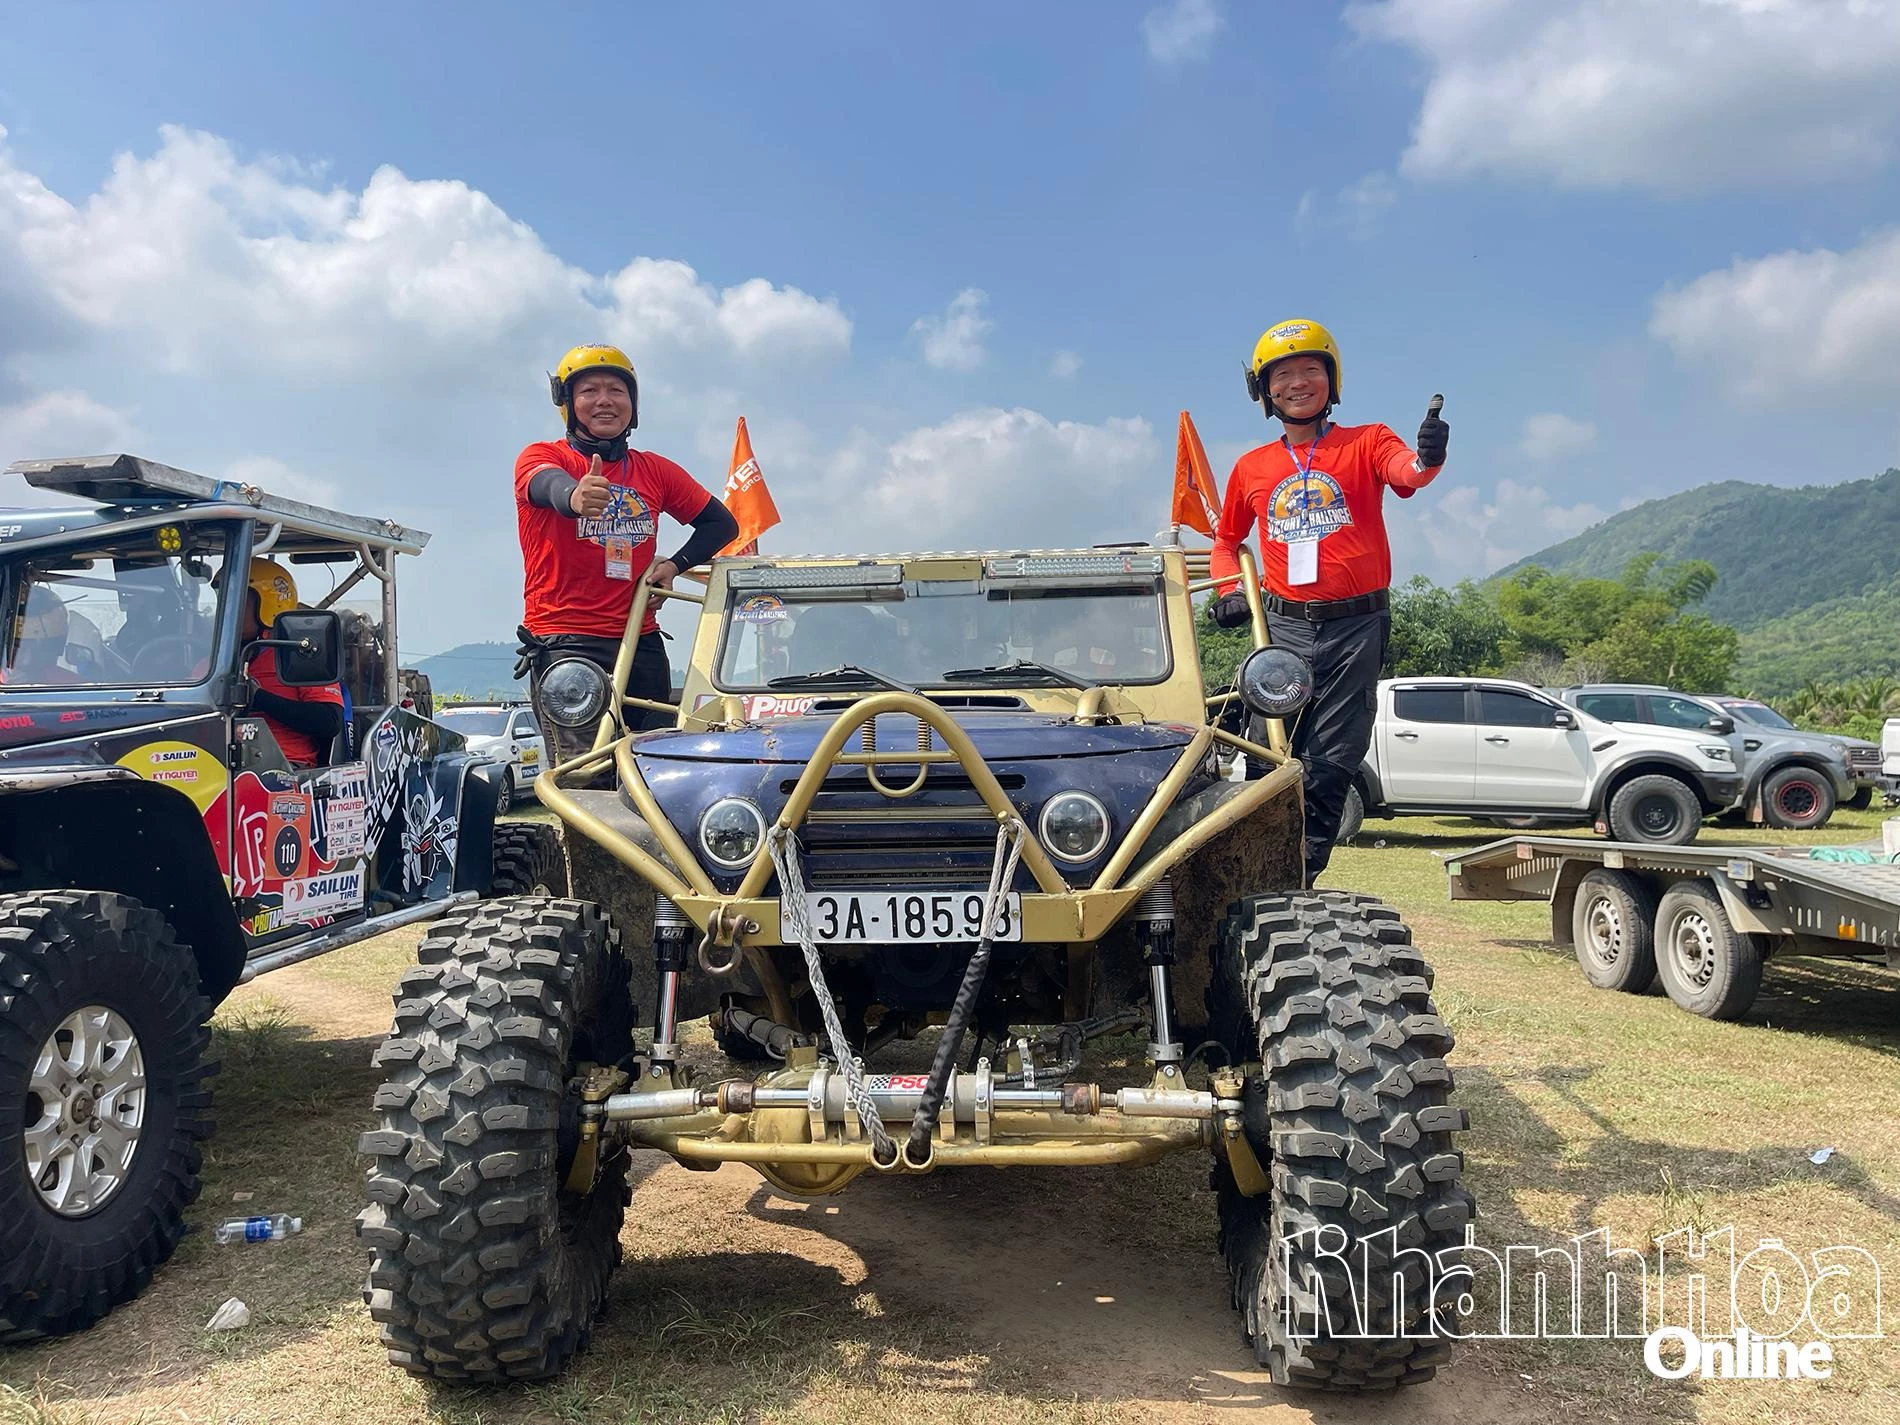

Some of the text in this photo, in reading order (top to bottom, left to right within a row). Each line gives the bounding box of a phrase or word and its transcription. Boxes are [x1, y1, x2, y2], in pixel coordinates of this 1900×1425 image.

[163, 751, 197, 761] SAILUN
[281, 843, 296, 864] 110
[307, 874, 360, 898] SAILUN
[340, 889, 357, 900] TIRE
